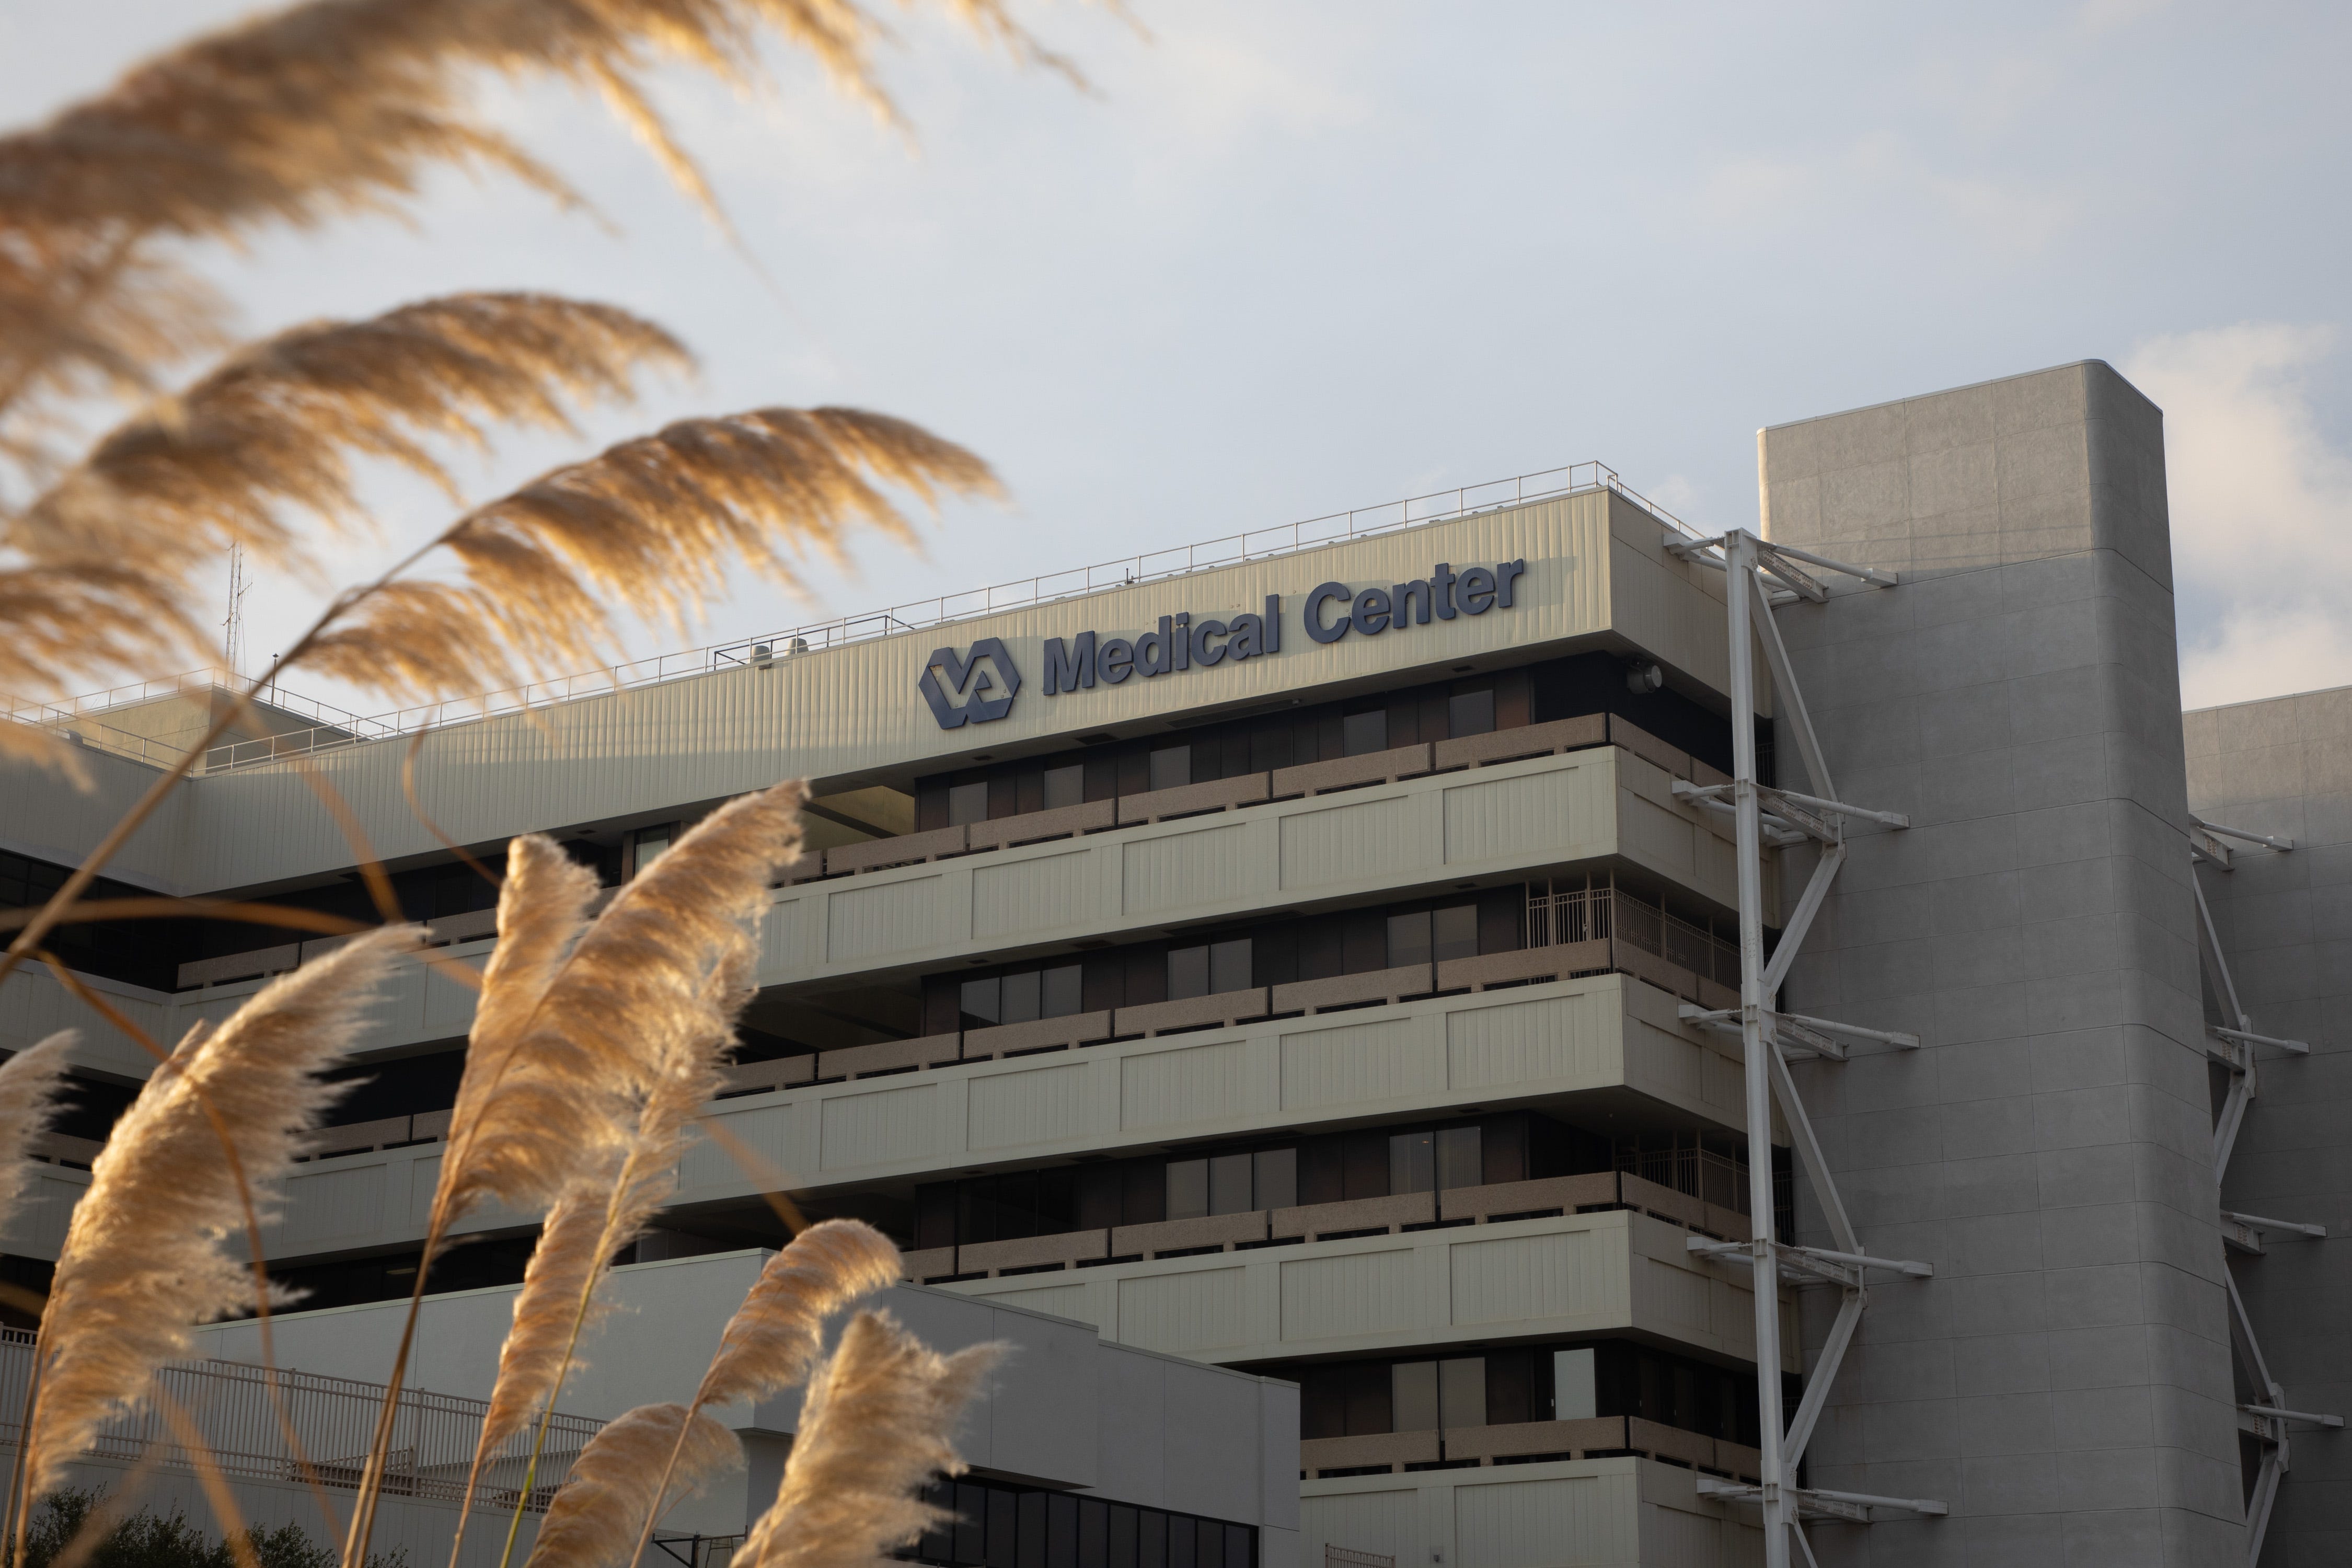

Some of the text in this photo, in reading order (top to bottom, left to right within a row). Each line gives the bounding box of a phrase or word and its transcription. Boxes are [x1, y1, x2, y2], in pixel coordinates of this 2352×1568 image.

[918, 558, 1524, 729] VA Medical Center
